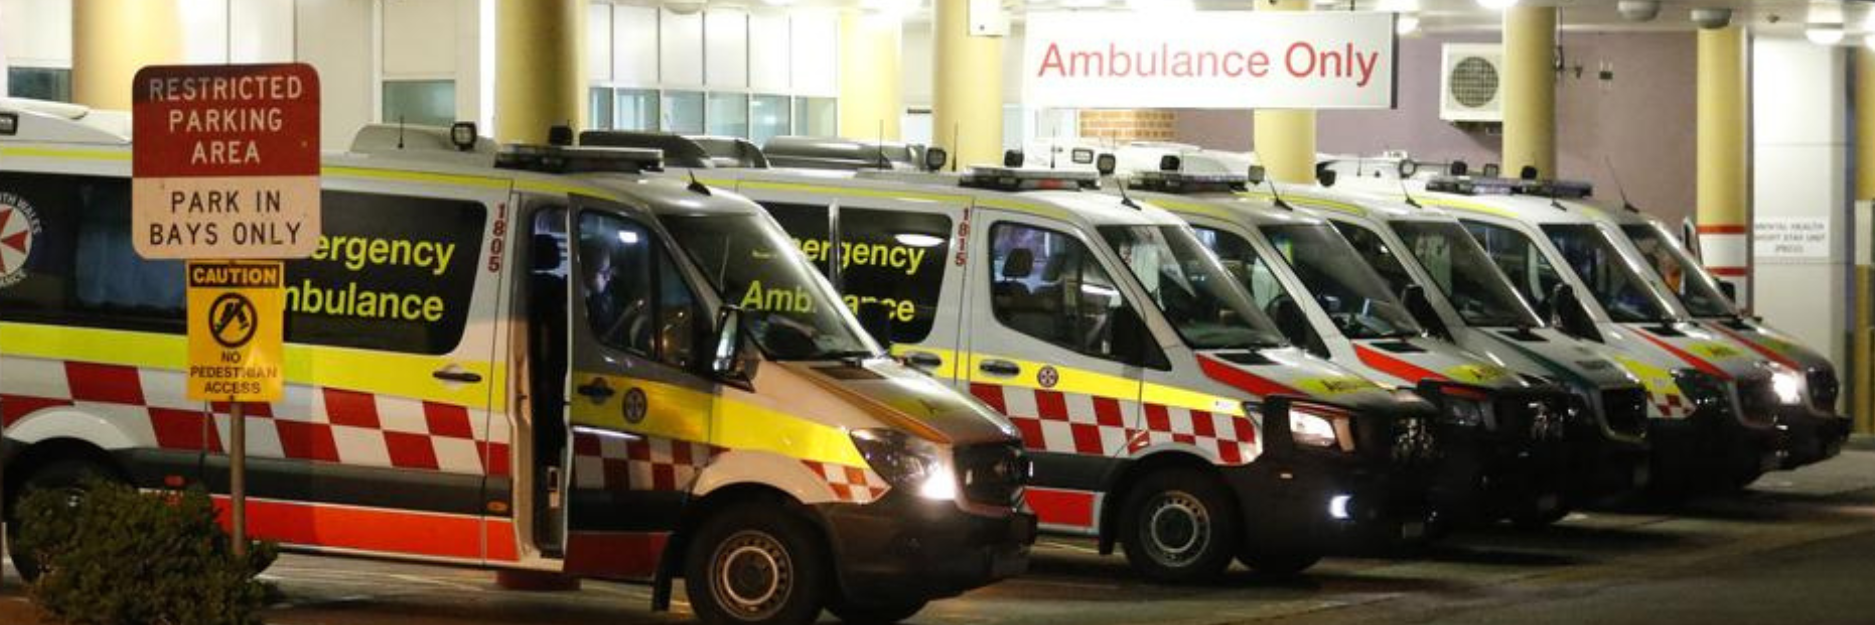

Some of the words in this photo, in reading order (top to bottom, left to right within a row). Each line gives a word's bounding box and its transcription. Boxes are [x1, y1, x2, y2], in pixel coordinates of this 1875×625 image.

[1038, 42, 1270, 78] Ambulance
[1284, 41, 1379, 87] Only
[149, 76, 303, 101] RESTRICTED
[168, 107, 283, 132] PARKING
[190, 140, 261, 165] AREA
[171, 189, 240, 213] PARK
[256, 189, 281, 213] IN
[150, 222, 218, 246] BAYS
[233, 221, 302, 245] ONLY
[487, 202, 507, 274] 1805
[311, 235, 455, 275] ergency
[193, 267, 278, 284] CAUTION
[284, 279, 444, 321] mbulance
[221, 350, 241, 363] NO
[190, 365, 278, 378] PEDESTRIAN
[204, 381, 262, 394] ACCESS
